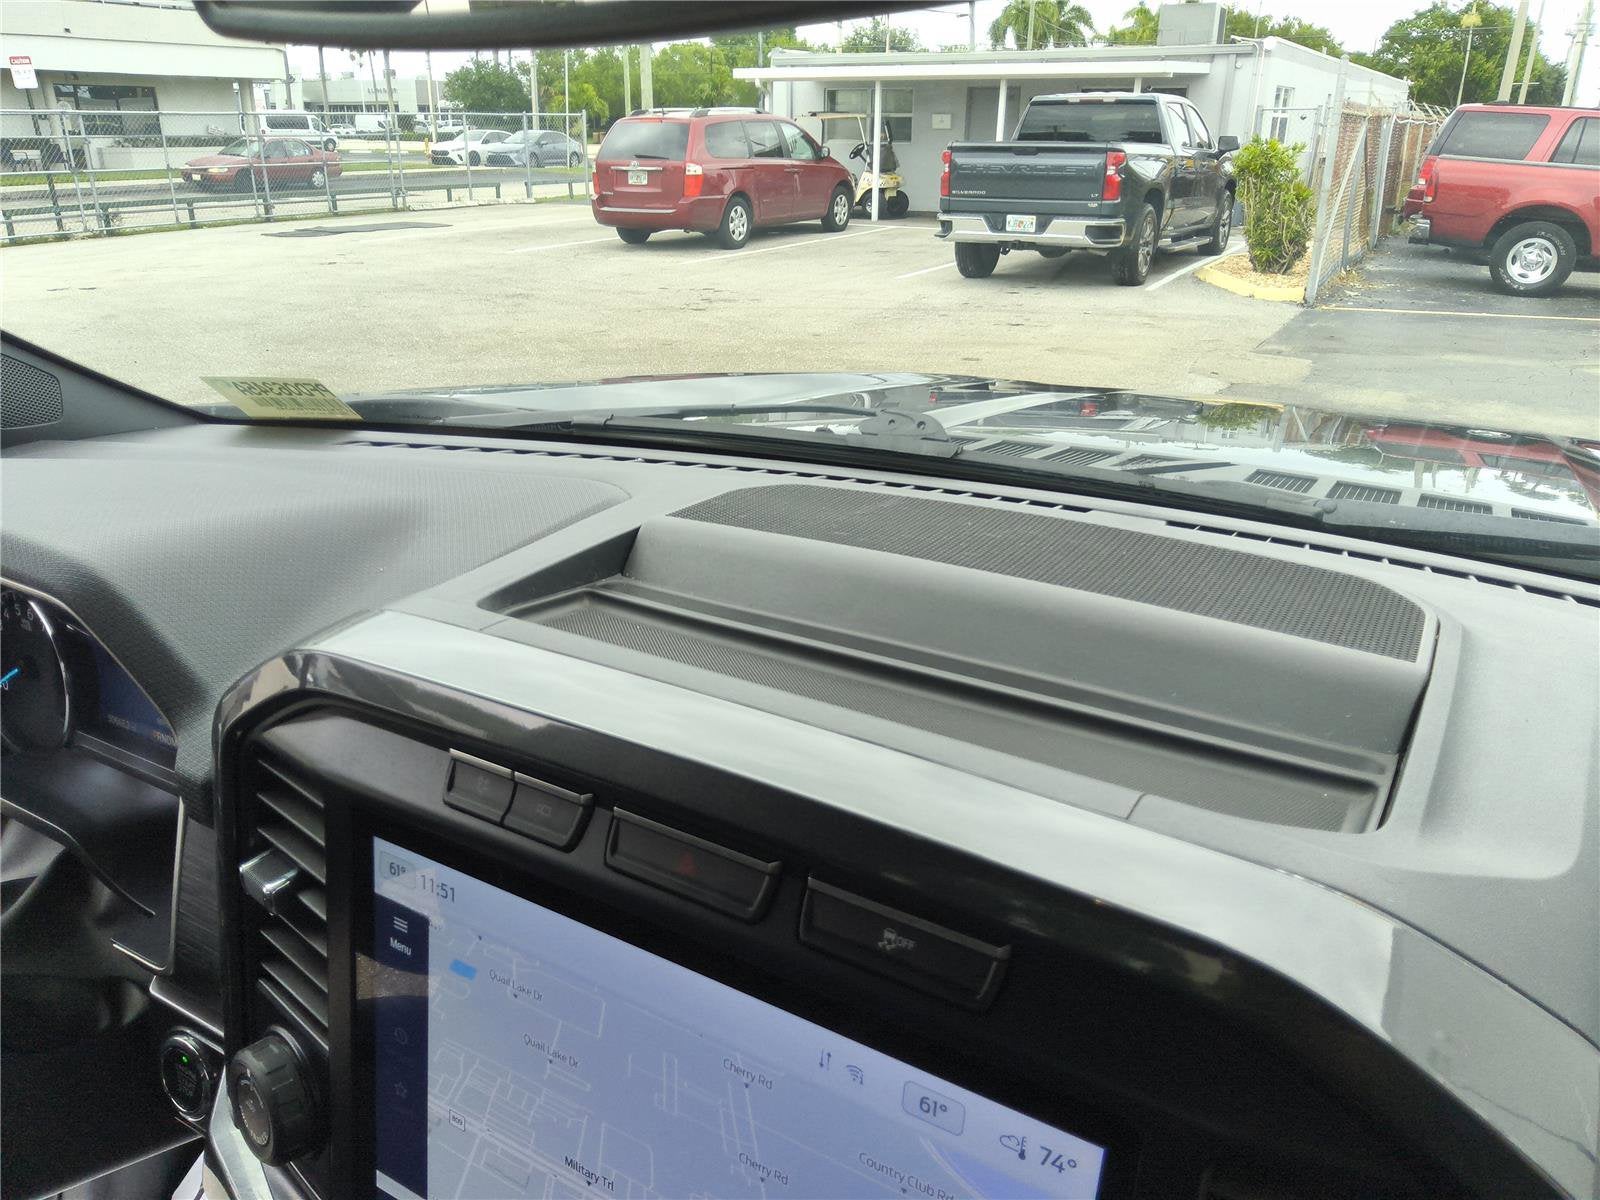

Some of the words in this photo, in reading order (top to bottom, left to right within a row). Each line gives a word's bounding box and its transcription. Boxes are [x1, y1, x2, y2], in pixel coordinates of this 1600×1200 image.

[959, 163, 1096, 176] CHEVROLET
[420, 874, 456, 903] 11:51
[390, 938, 412, 956] Menu
[489, 969, 512, 988] Quail
[512, 979, 533, 998] Lake
[533, 990, 544, 1002] Dr
[523, 1033, 546, 1053] Quail
[548, 1044, 568, 1064] Lake
[568, 1056, 580, 1069] Dr
[722, 1057, 755, 1083] Cherry
[757, 1073, 773, 1090] Rd
[564, 1155, 600, 1183] Military
[601, 1175, 616, 1191] Trl
[738, 1152, 772, 1178] Cherry
[774, 1169, 789, 1185] Rd
[858, 1152, 907, 1184] Country
[906, 1174, 936, 1195] Club
[937, 1185, 954, 1200] Rd
[1038, 1146, 1078, 1174] 74°
